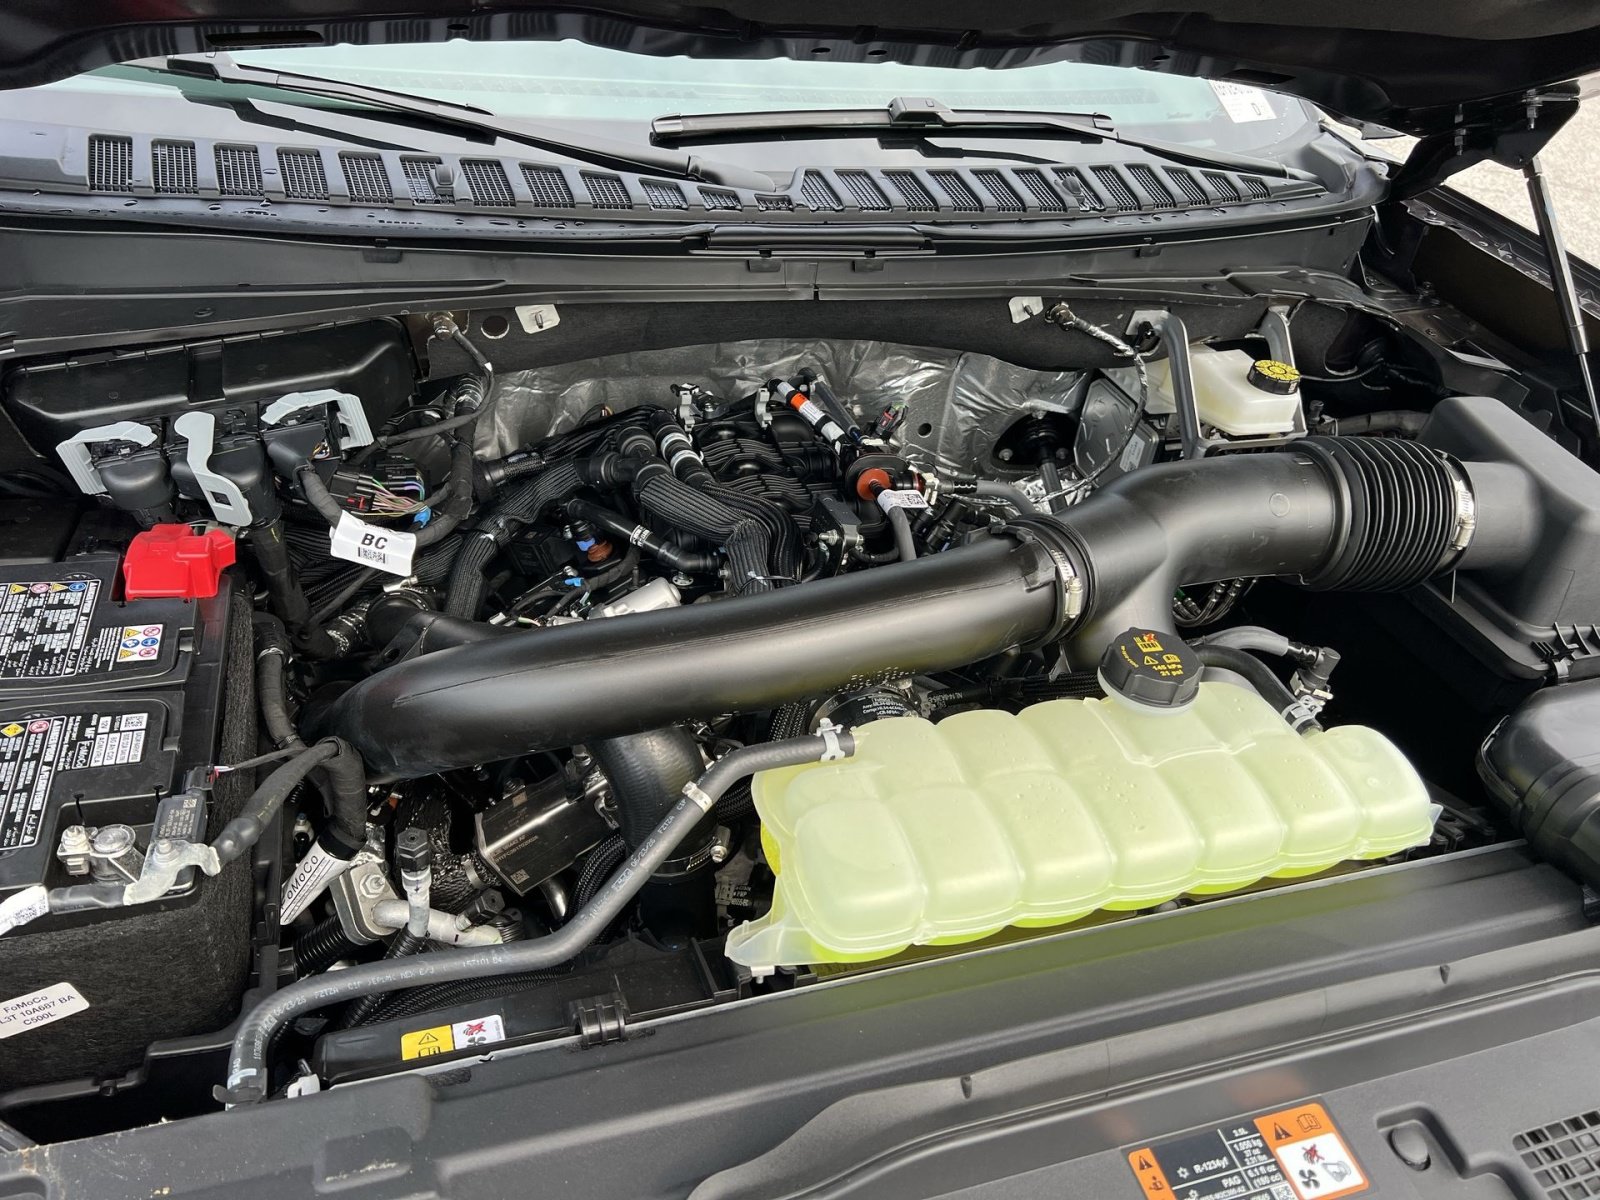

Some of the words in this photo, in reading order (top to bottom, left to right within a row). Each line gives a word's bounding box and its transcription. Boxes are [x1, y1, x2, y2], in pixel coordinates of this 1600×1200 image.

[360, 533, 388, 550] BC
[76, 742, 90, 768] FoMoCo
[3, 995, 48, 1013] FoMoCo
[20, 1000, 56, 1017] 10A687
[58, 994, 76, 1004] BA
[23, 1011, 56, 1025] C500L
[1252, 1138, 1263, 1148] kg
[1193, 1156, 1229, 1174] R-1234yf
[1247, 1168, 1260, 1178] 6.1
[1221, 1175, 1242, 1188] PAG
